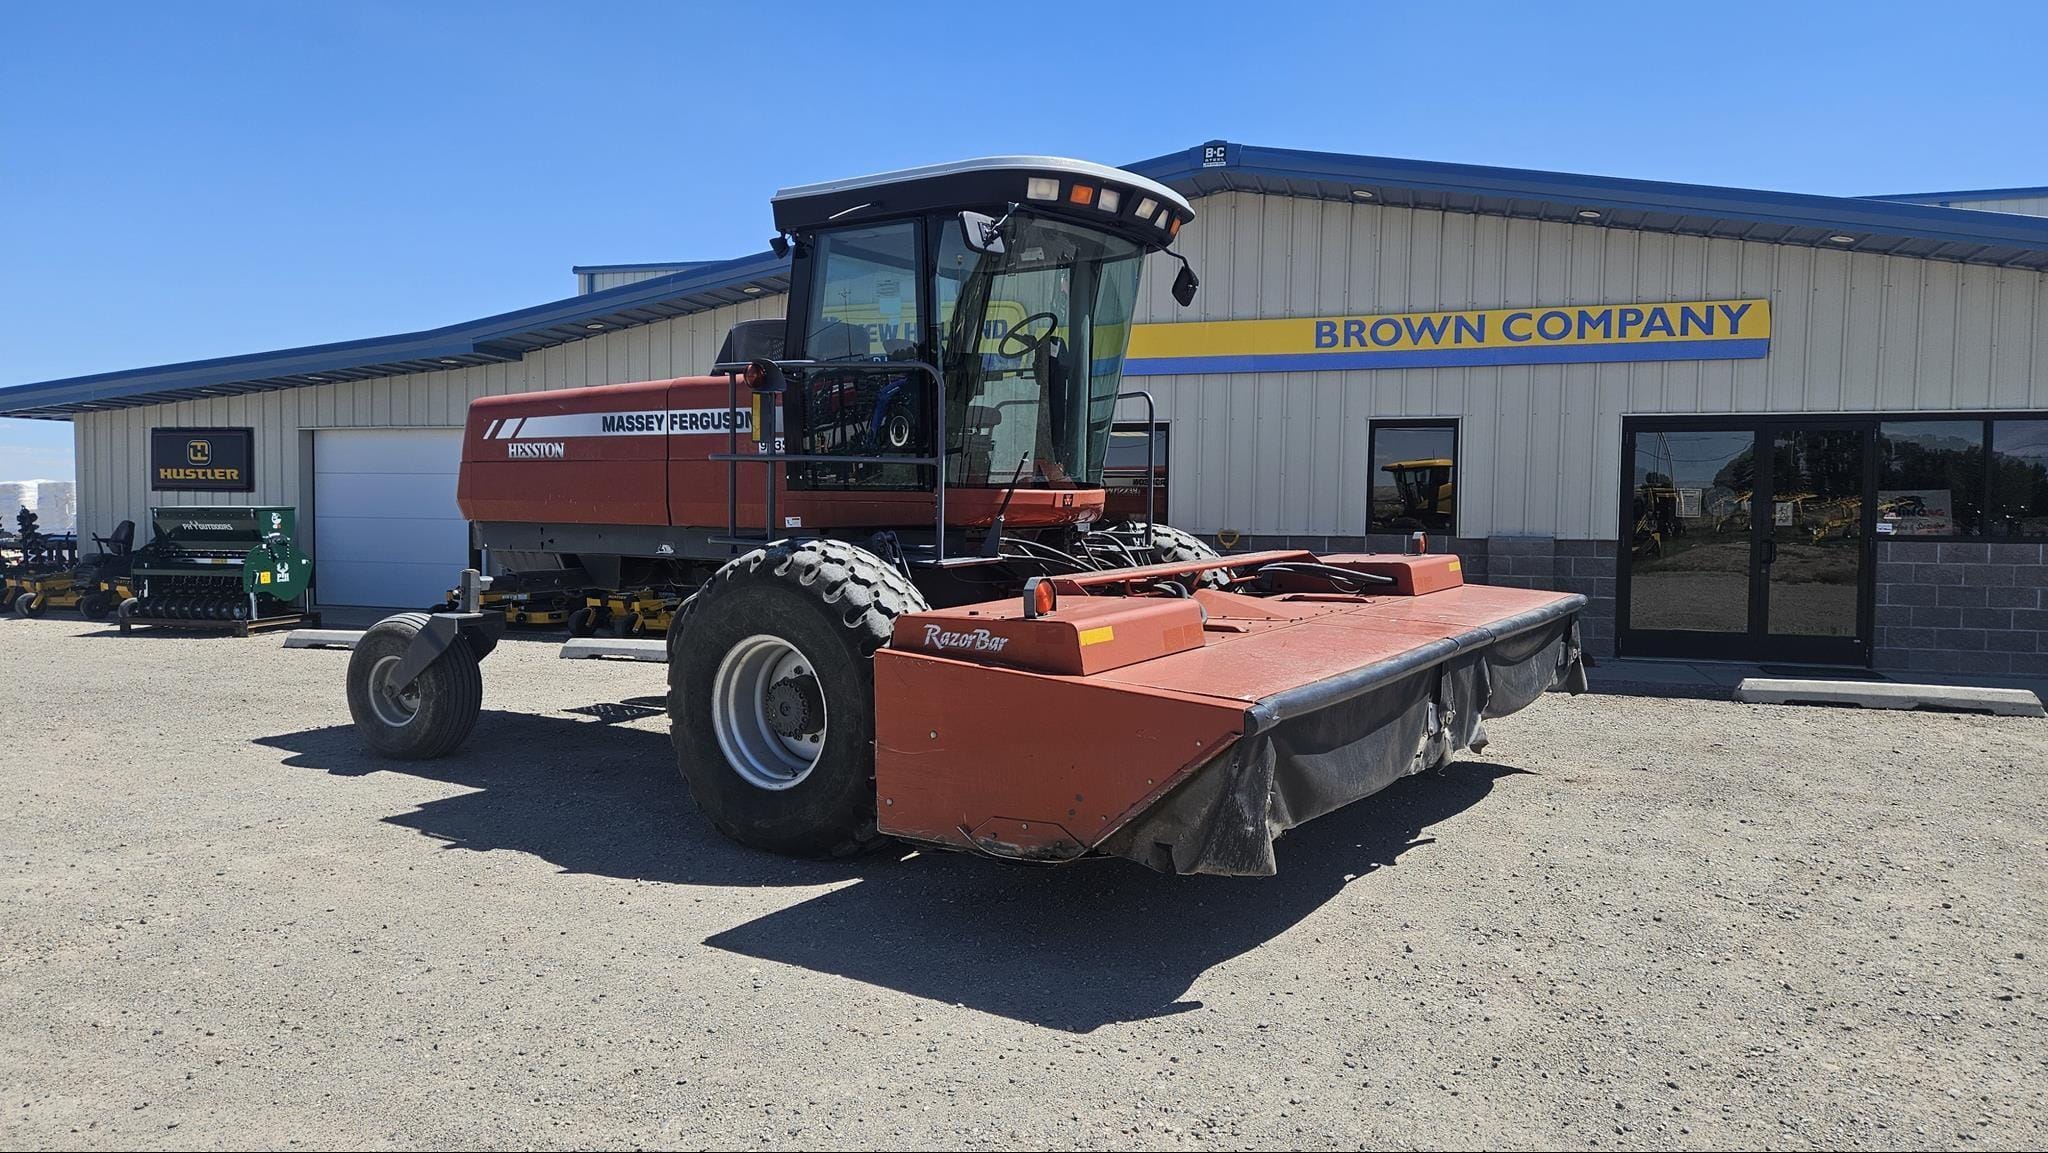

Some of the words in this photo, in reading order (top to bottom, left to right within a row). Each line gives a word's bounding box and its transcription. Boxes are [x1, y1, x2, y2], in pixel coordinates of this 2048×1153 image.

[1314, 314, 1486, 349] BROWN
[1502, 303, 1752, 342] COMPANY
[602, 413, 665, 433] MASSEY
[669, 411, 752, 431] FERGUSON
[508, 442, 564, 459] HESSTON
[159, 468, 240, 480] HUSTLER
[923, 624, 1009, 652] RazorBar
